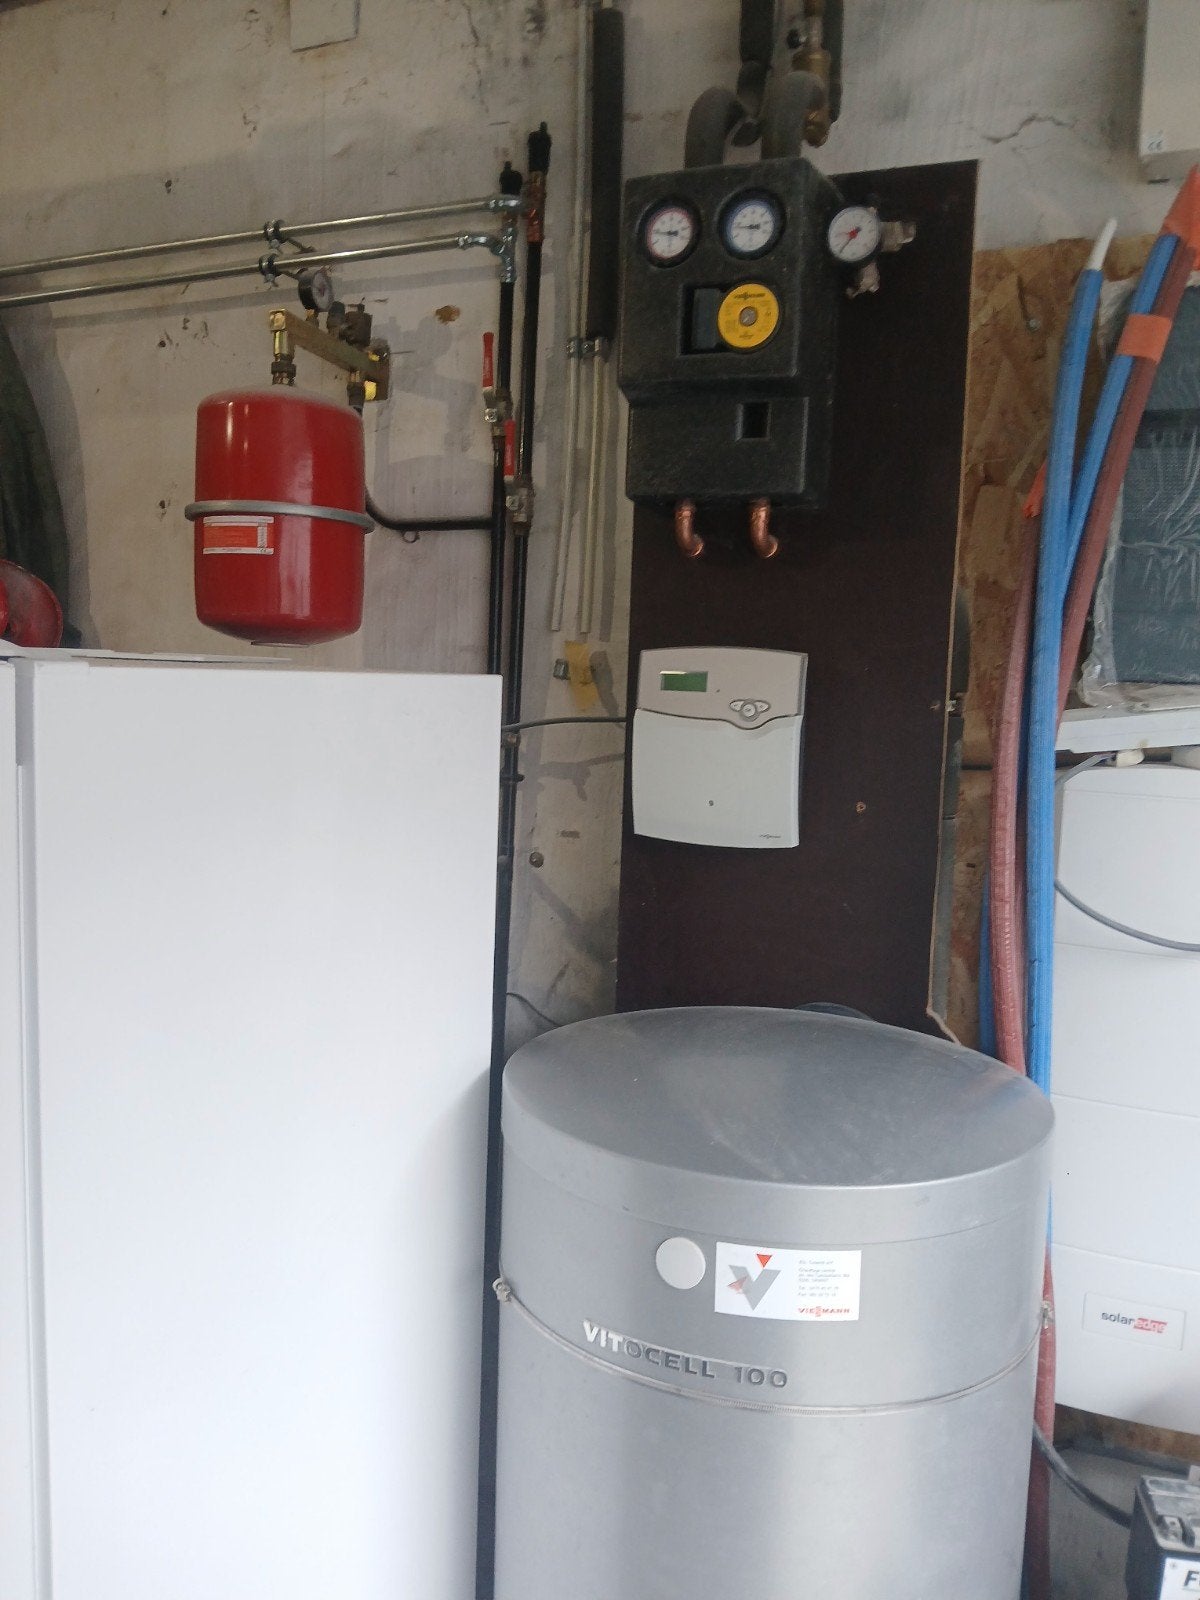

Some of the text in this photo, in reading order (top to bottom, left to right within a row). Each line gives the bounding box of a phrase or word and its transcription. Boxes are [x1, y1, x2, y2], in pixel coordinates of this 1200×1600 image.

[582, 1318, 788, 1388] VITOCELL 100
[1183, 1570, 1200, 1587] F
